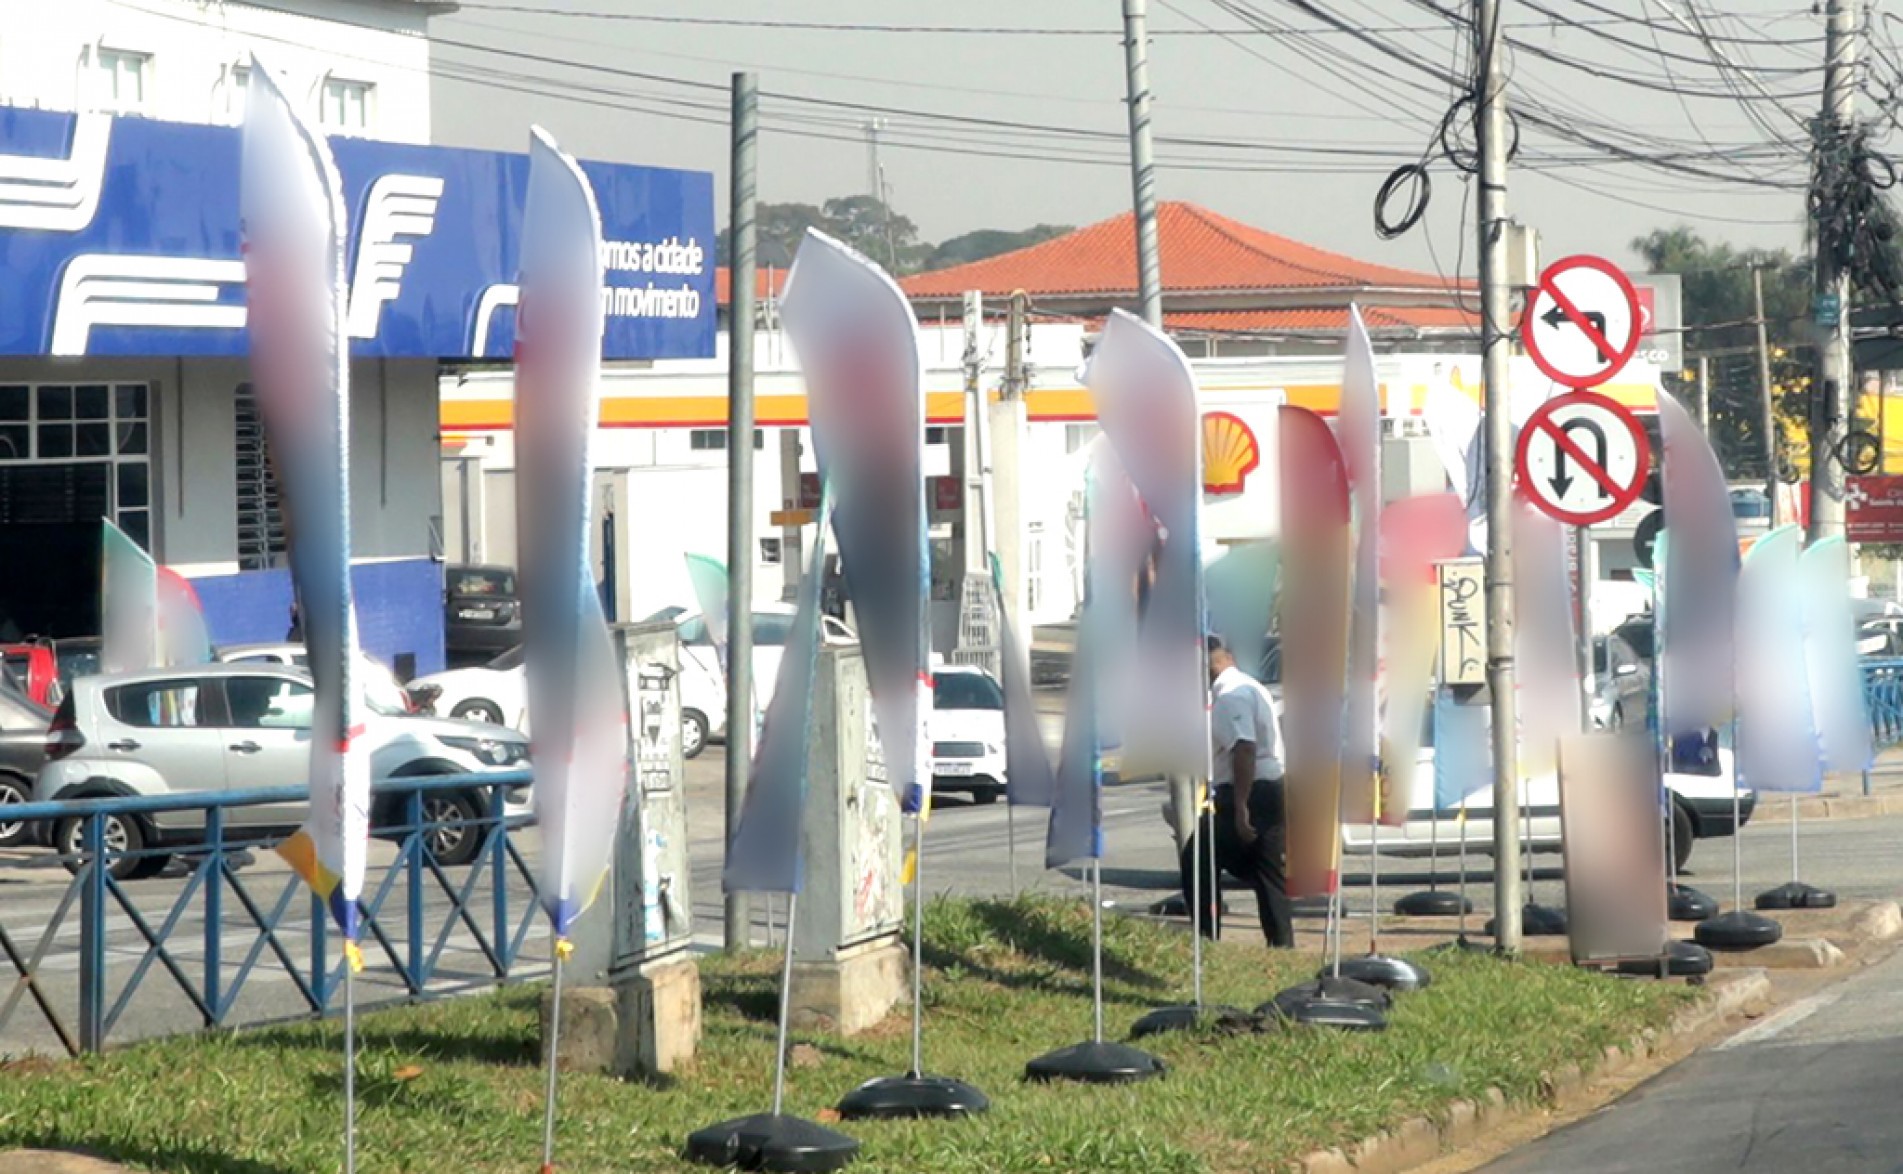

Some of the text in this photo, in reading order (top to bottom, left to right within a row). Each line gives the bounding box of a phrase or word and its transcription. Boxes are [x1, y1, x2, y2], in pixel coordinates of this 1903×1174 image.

[643, 242, 653, 273] a
[654, 236, 703, 275] cidade
[615, 282, 700, 318] movimento
